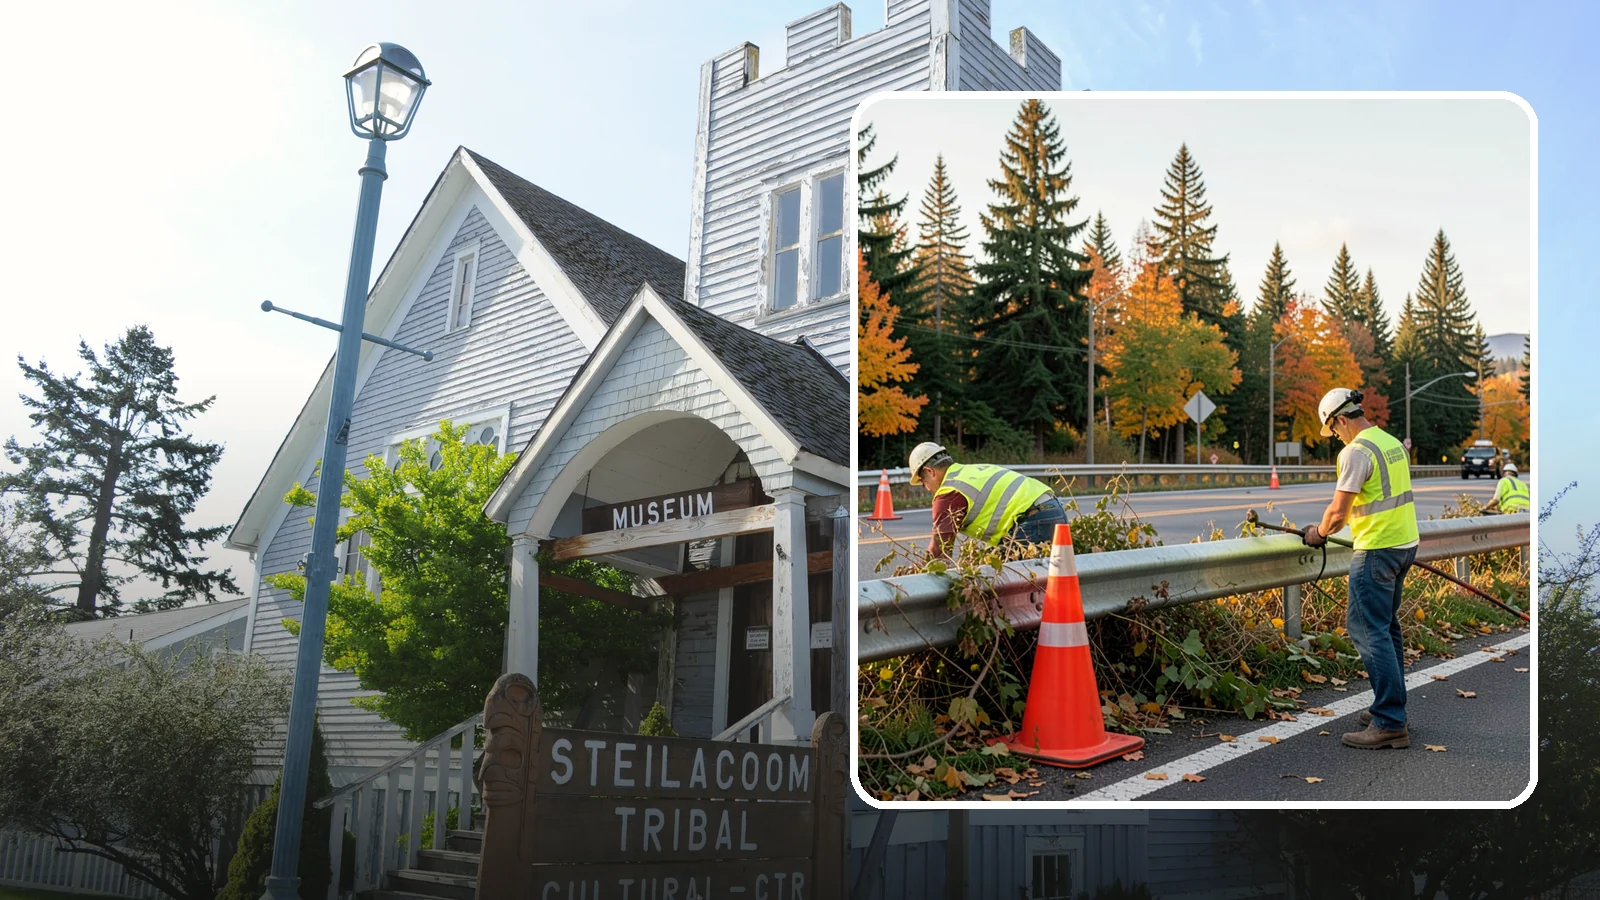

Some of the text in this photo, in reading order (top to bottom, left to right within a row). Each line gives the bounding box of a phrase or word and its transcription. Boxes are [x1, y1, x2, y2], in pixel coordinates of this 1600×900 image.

[612, 491, 714, 531] MUSEUM
[550, 738, 810, 792] STEILACOOM
[614, 806, 758, 852] TRIBAL
